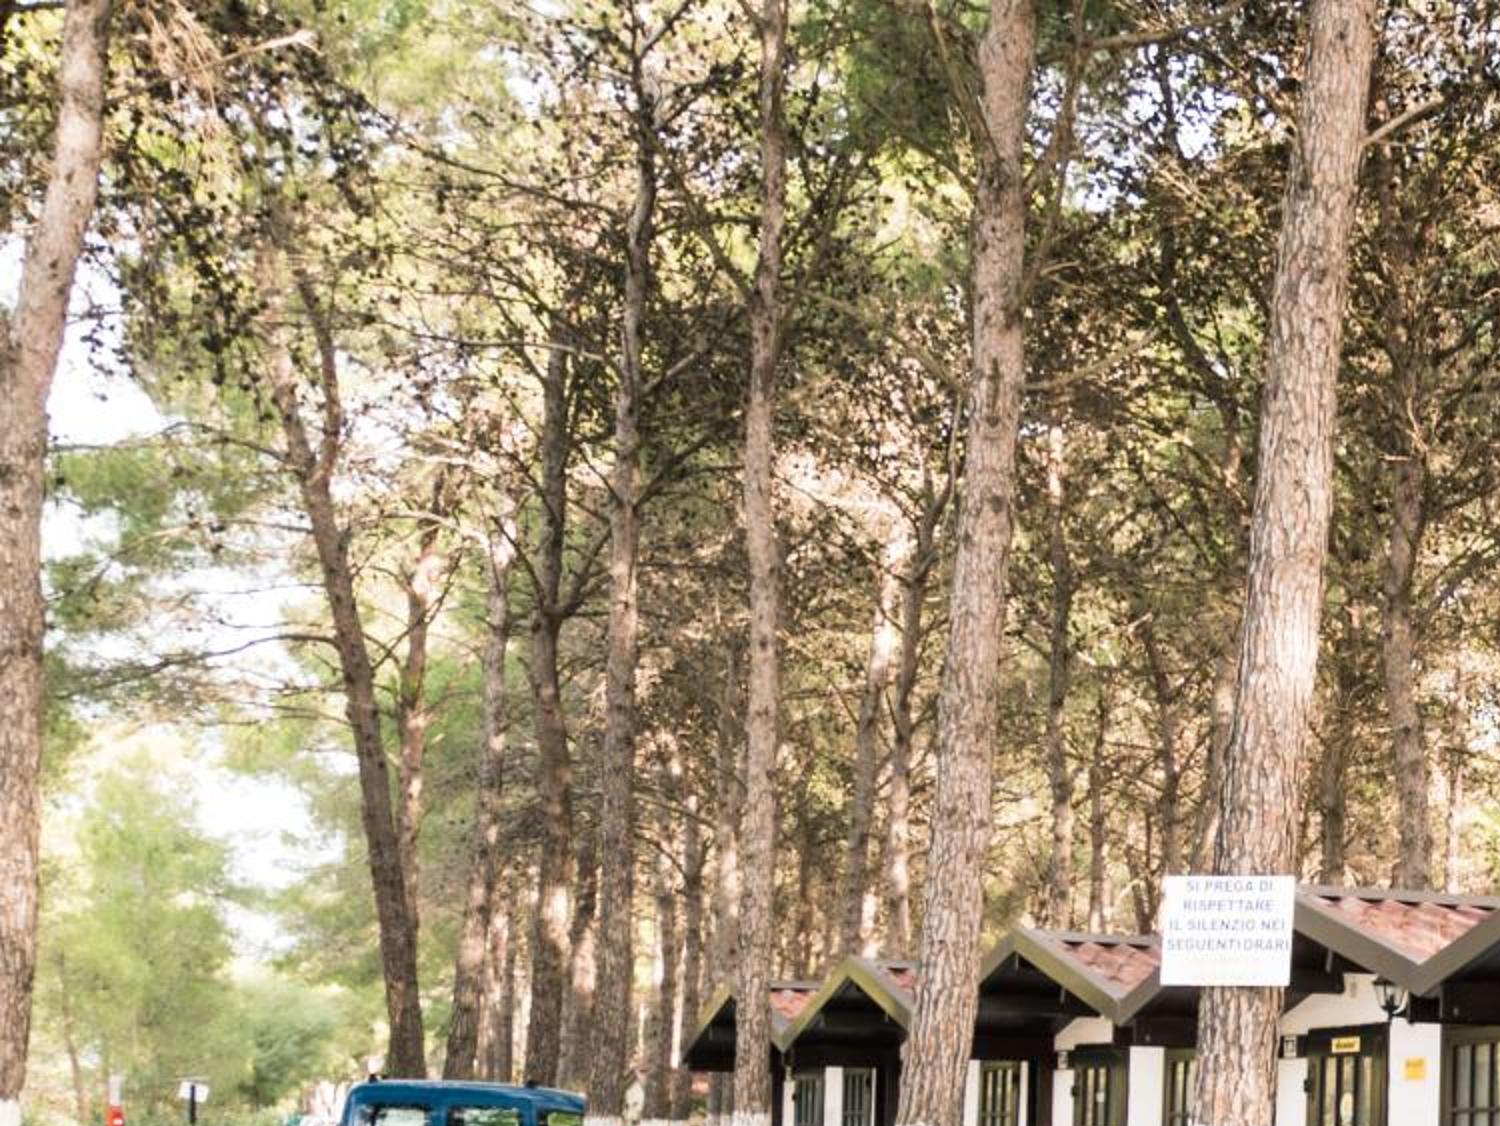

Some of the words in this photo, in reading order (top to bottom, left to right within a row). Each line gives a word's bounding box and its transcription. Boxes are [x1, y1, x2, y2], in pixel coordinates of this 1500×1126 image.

[1186, 879, 1199, 892] SI
[1204, 879, 1253, 892] PREGA
[1259, 879, 1273, 892] DI
[1183, 899, 1273, 912] RISPETTARE
[1169, 919, 1182, 931] IL
[1187, 919, 1255, 931] SILENZIO
[1261, 919, 1285, 931] NEI
